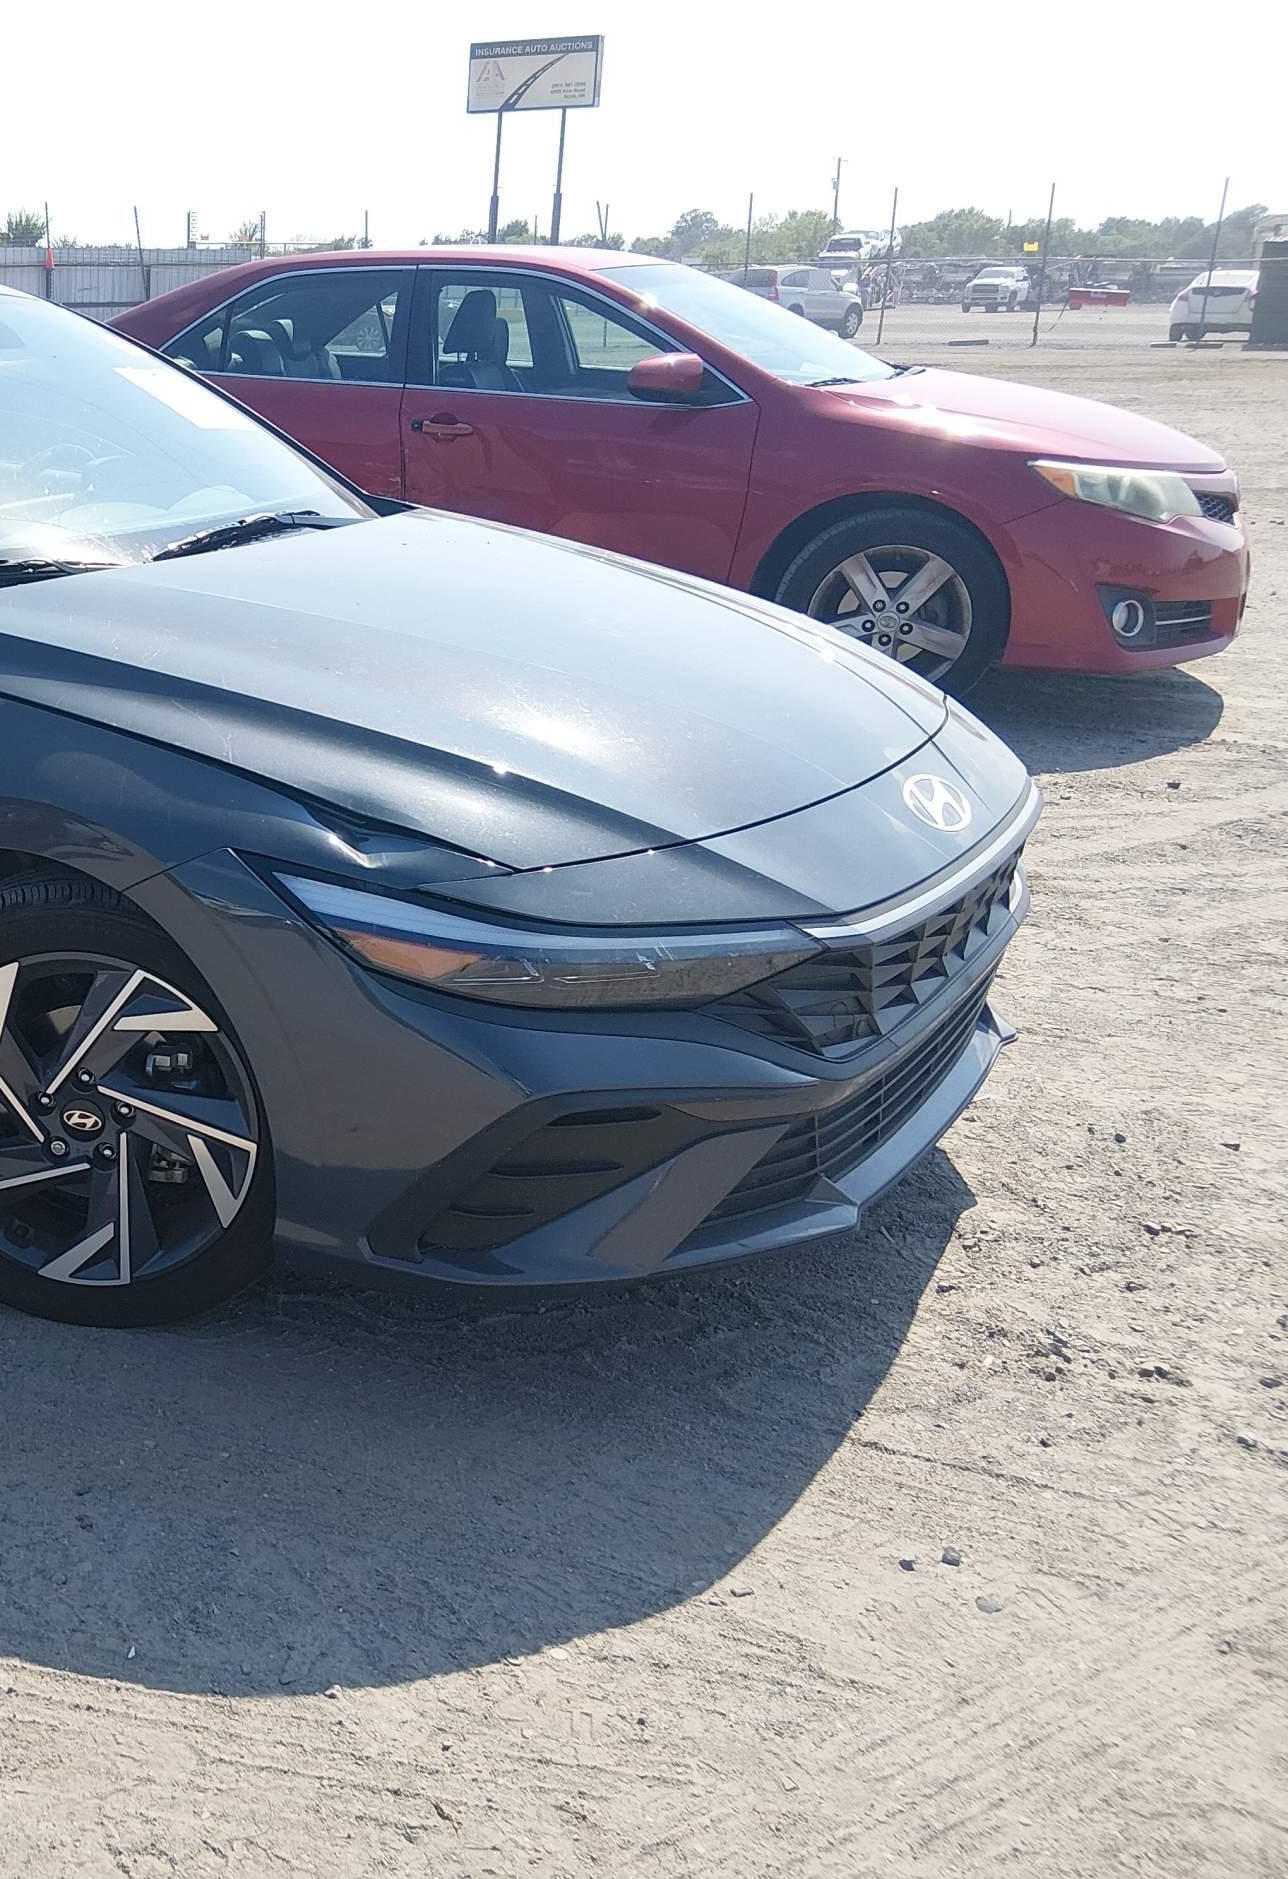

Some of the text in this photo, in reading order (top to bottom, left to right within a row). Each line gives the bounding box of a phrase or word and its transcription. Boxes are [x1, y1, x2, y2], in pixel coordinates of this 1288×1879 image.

[475, 41, 593, 57] INSURANCE AUTO AUCTIONS
